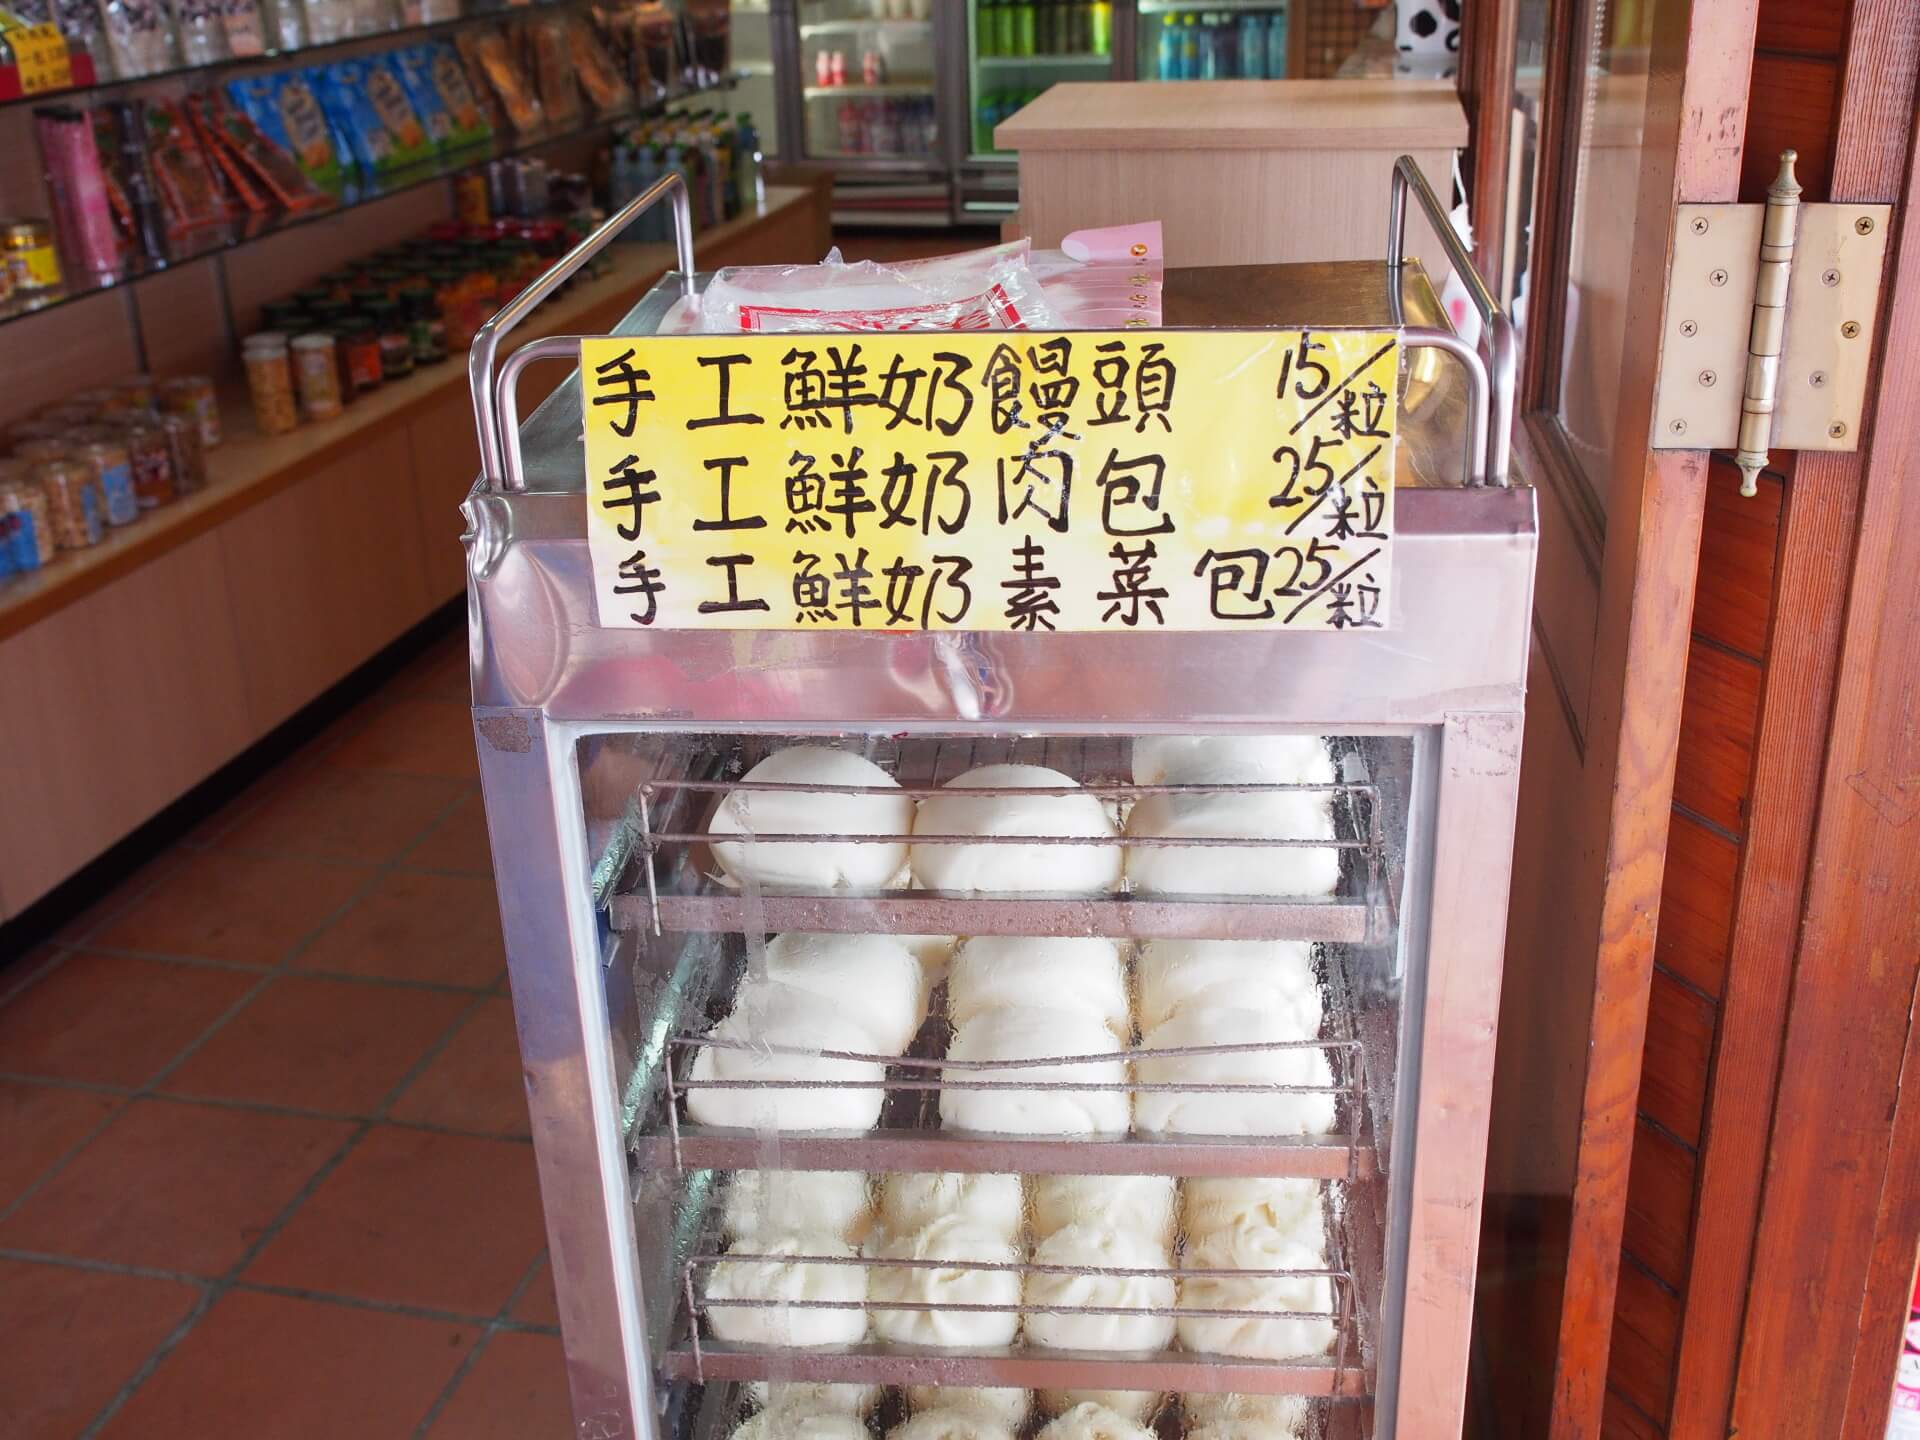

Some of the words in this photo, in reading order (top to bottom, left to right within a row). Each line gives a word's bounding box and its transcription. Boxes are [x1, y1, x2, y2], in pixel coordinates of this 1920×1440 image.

[592, 336, 1177, 440] 手工鮮奶饅頭
[1276, 331, 1397, 438] 15/粒
[602, 440, 1176, 541] 手工鮮奶肉包
[1268, 435, 1389, 540] 25/粒
[613, 534, 1274, 632] 手工鮮奶素菜包
[1273, 536, 1383, 629] 25/粒
